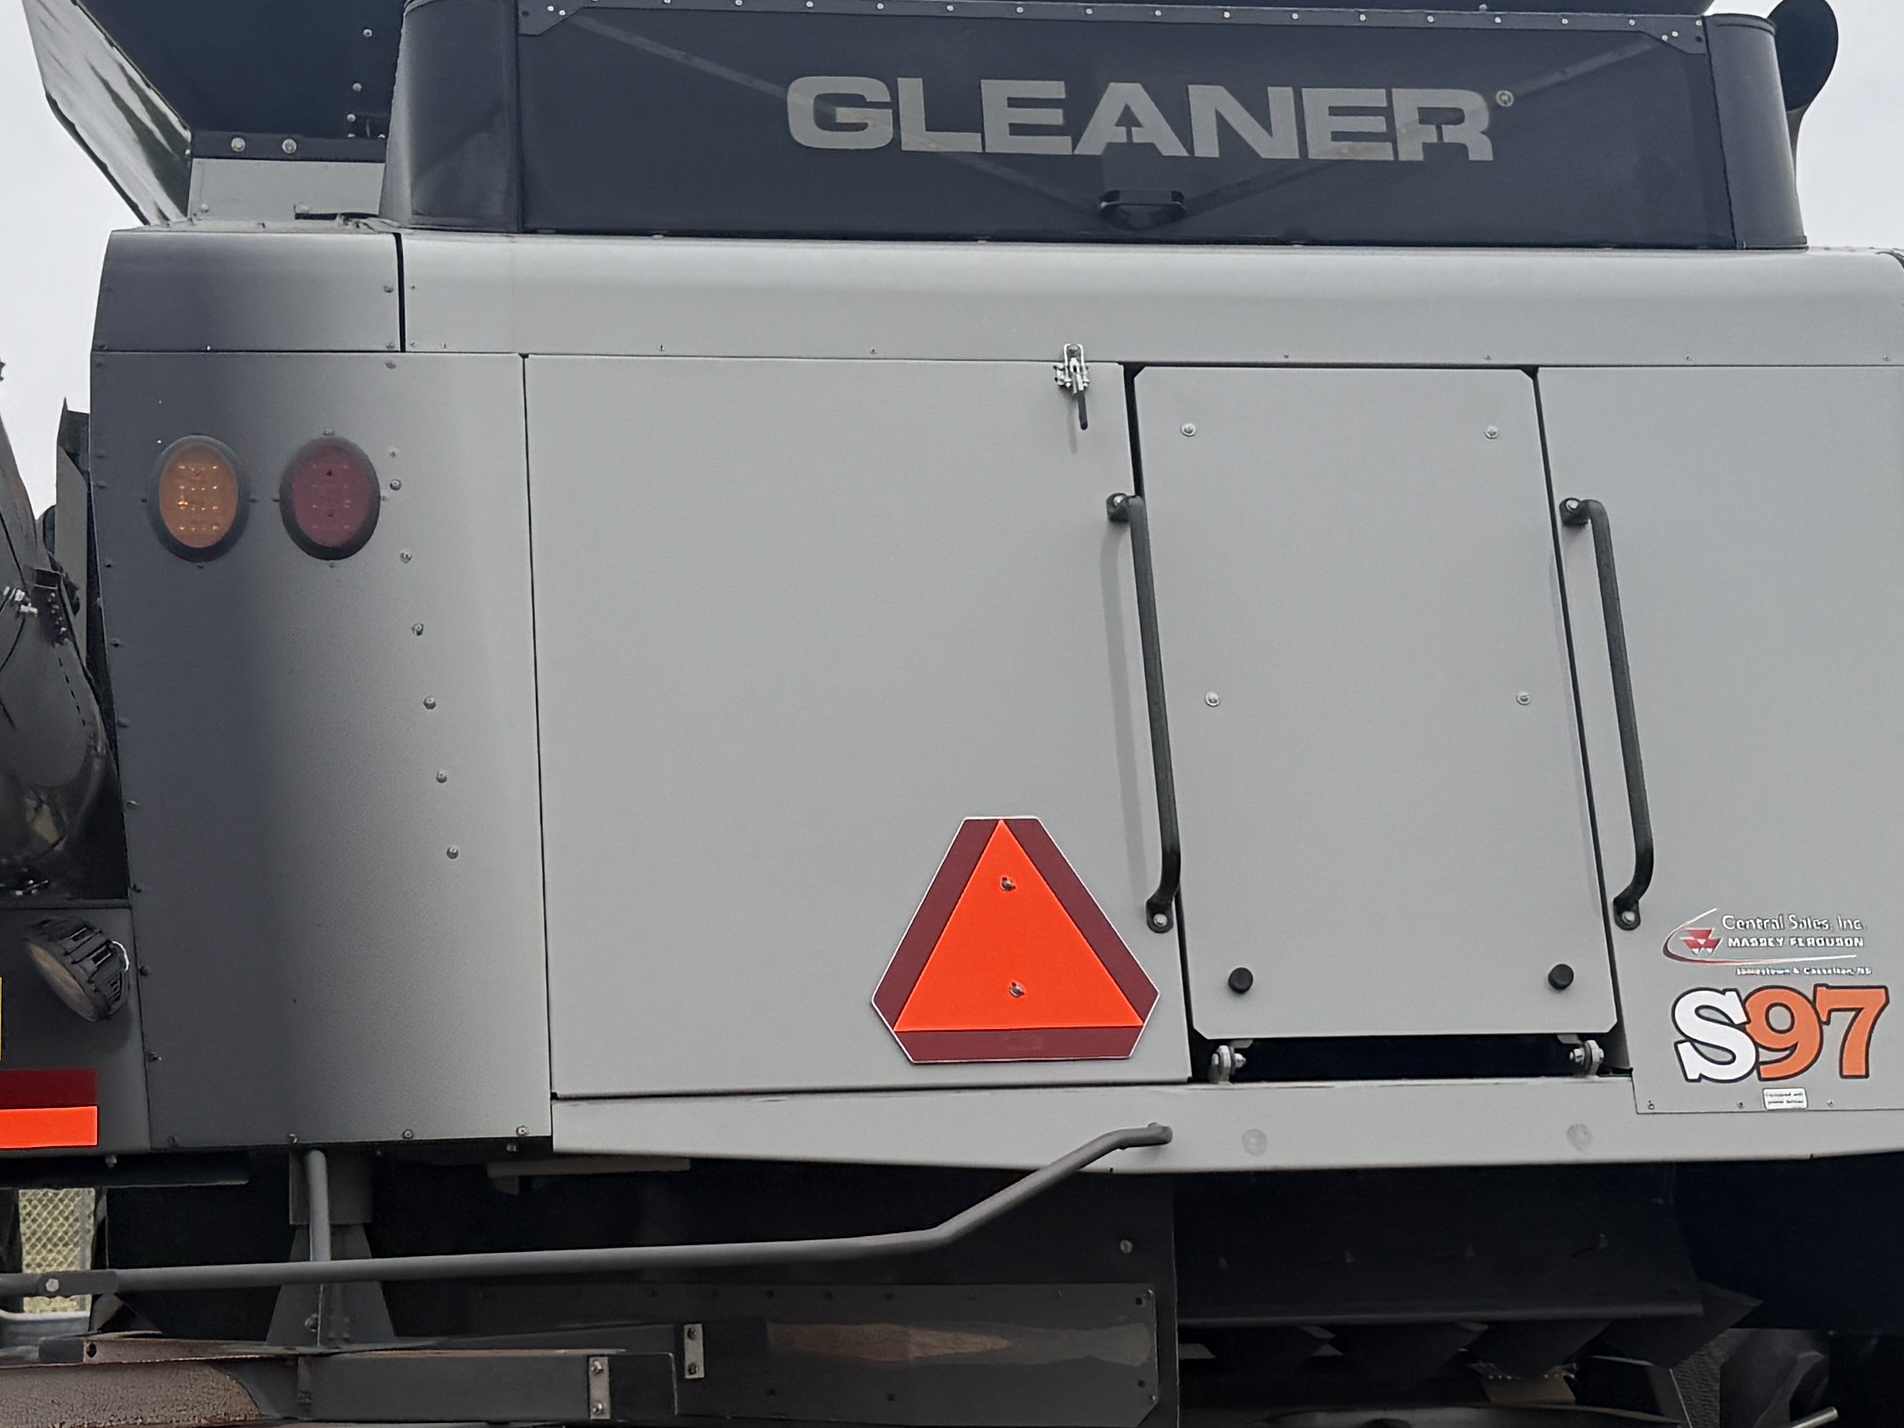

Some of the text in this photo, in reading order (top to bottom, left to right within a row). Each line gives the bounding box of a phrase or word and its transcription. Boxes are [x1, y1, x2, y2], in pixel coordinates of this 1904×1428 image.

[786, 75, 1494, 162] GLEANER
[1722, 914, 1784, 931] Central
[1727, 936, 1865, 948] MASSEY FERGUSON
[1671, 983, 1890, 1083] S97
